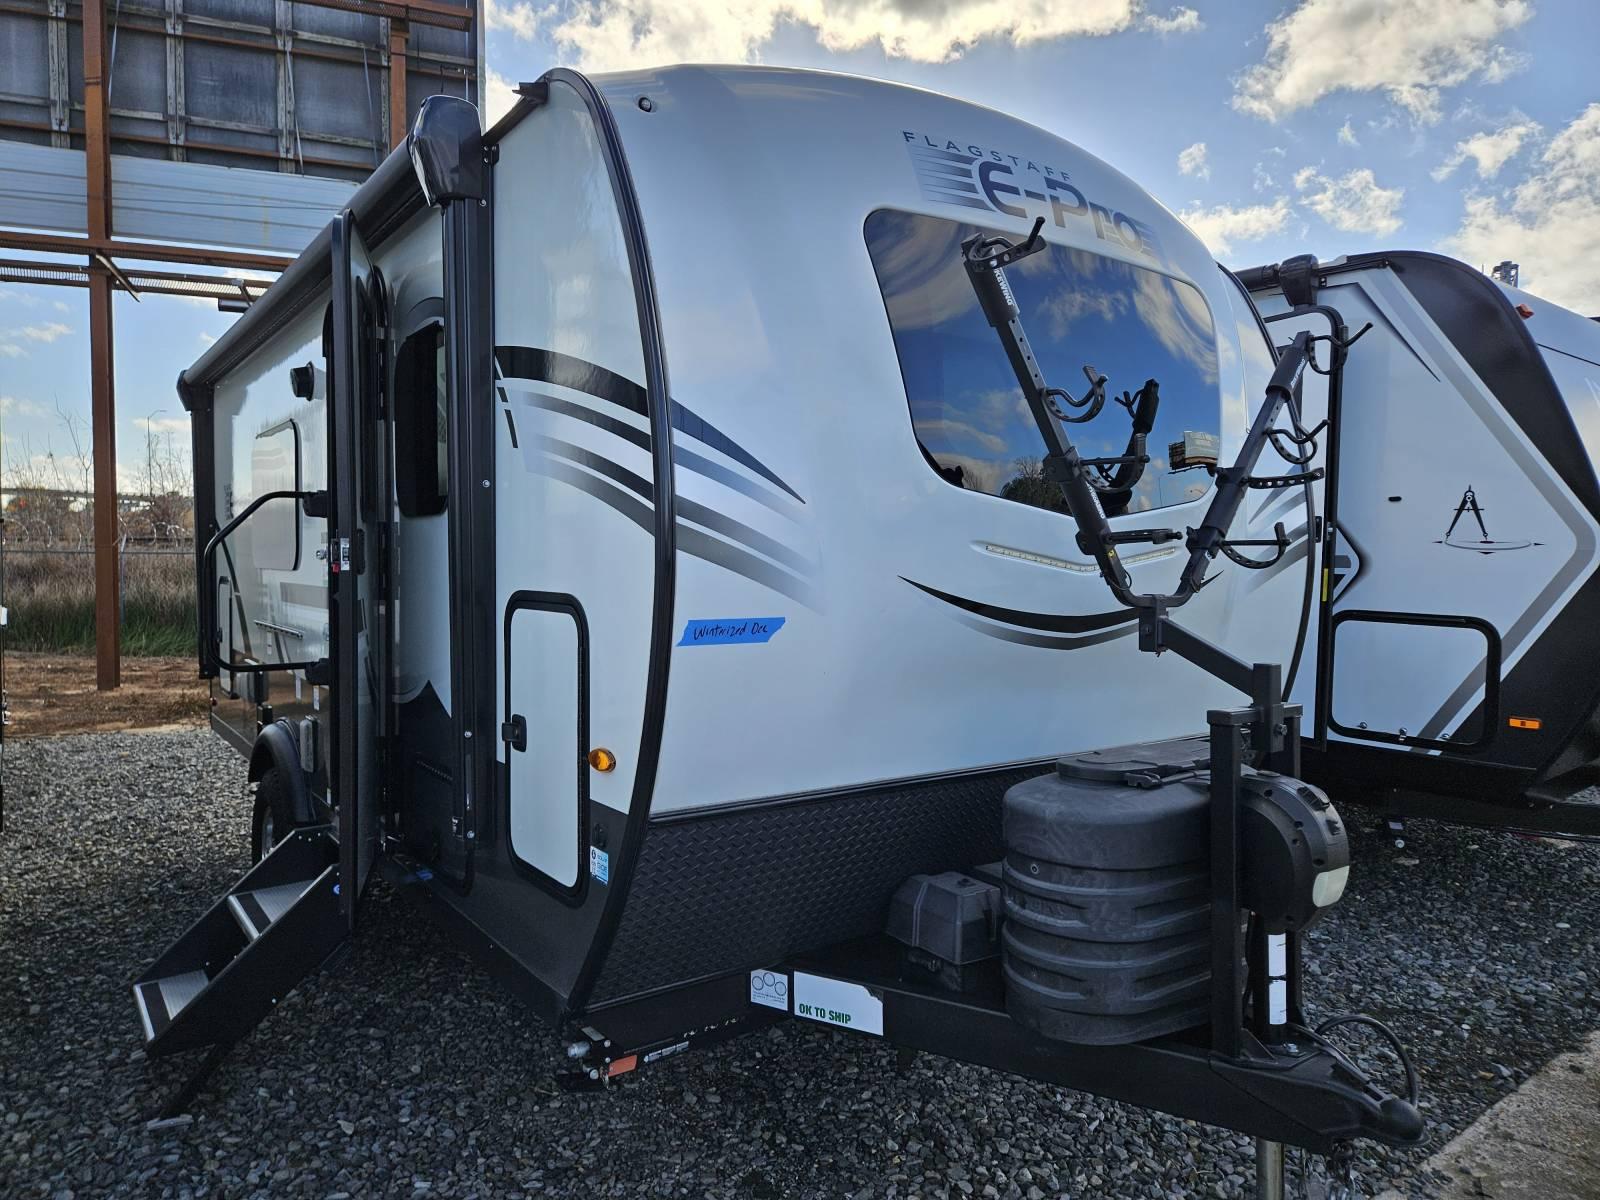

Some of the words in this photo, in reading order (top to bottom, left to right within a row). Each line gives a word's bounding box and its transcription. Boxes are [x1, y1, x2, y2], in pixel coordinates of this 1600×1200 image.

[903, 131, 1072, 181] FLAGSTAFF
[800, 1004, 812, 1015] OK
[815, 1007, 826, 1018] TO
[829, 1011, 851, 1024] SHIP
